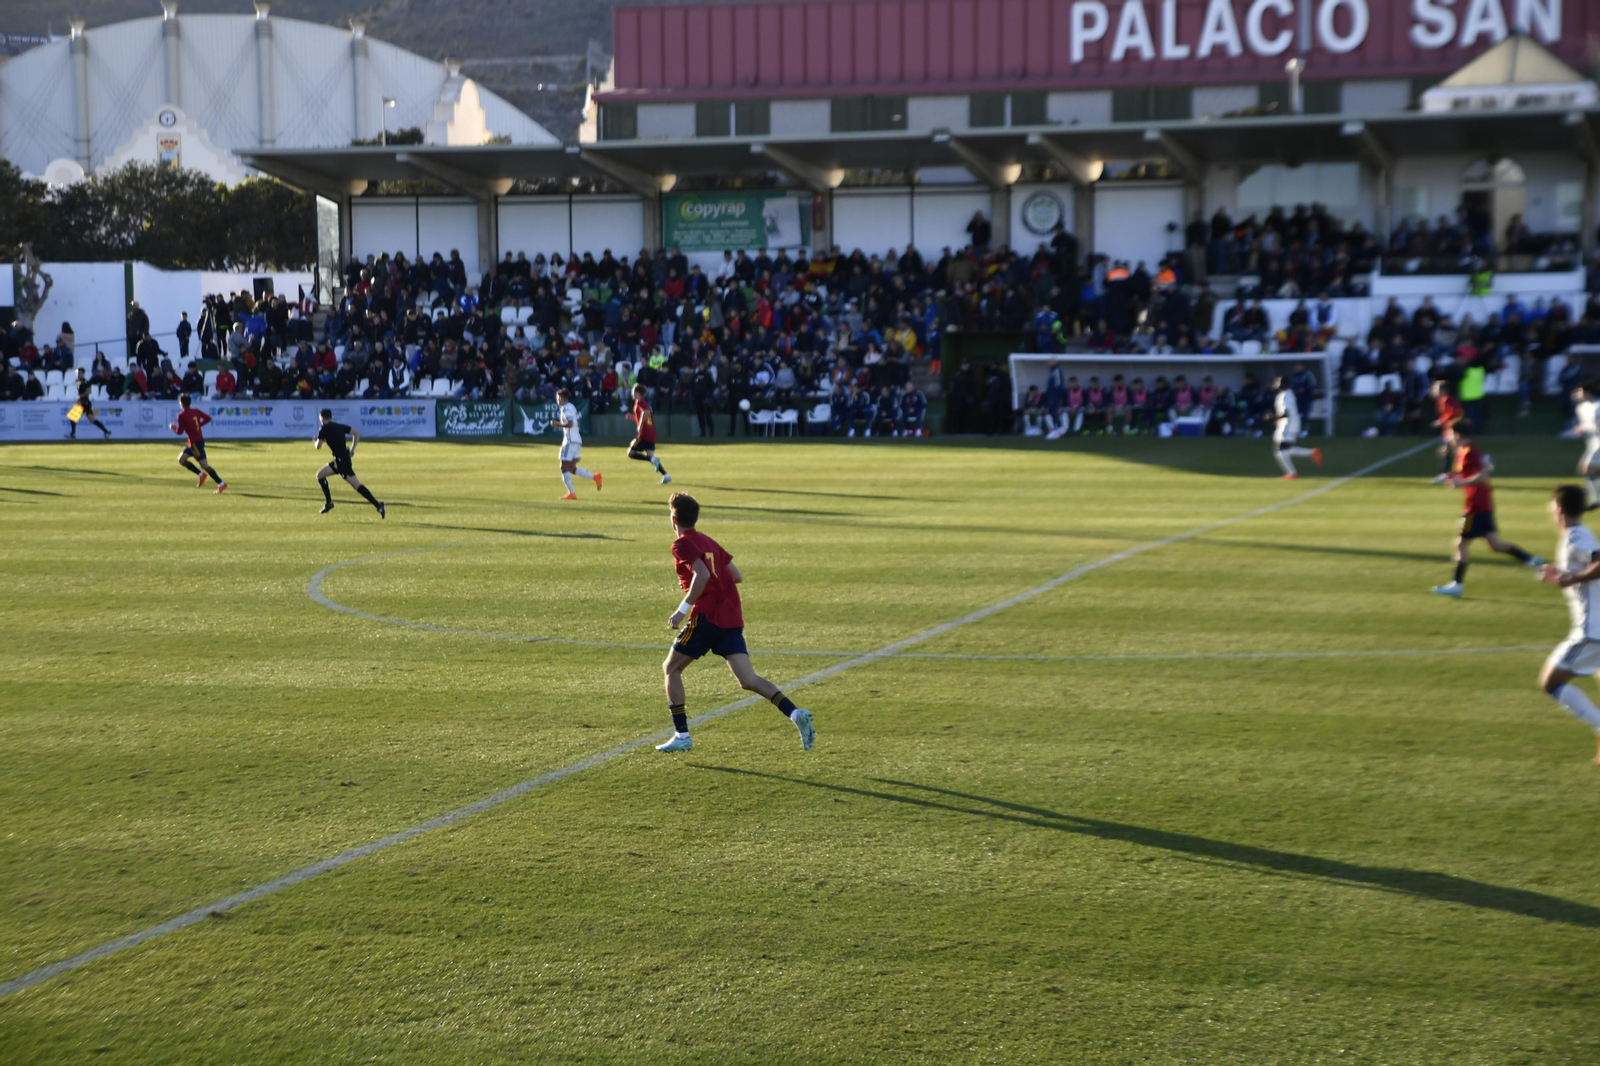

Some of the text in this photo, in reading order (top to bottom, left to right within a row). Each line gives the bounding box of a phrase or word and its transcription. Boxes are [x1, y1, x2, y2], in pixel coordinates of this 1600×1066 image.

[1070, 0, 1562, 63] PALACIO SAN
[685, 202, 746, 219] copyrap
